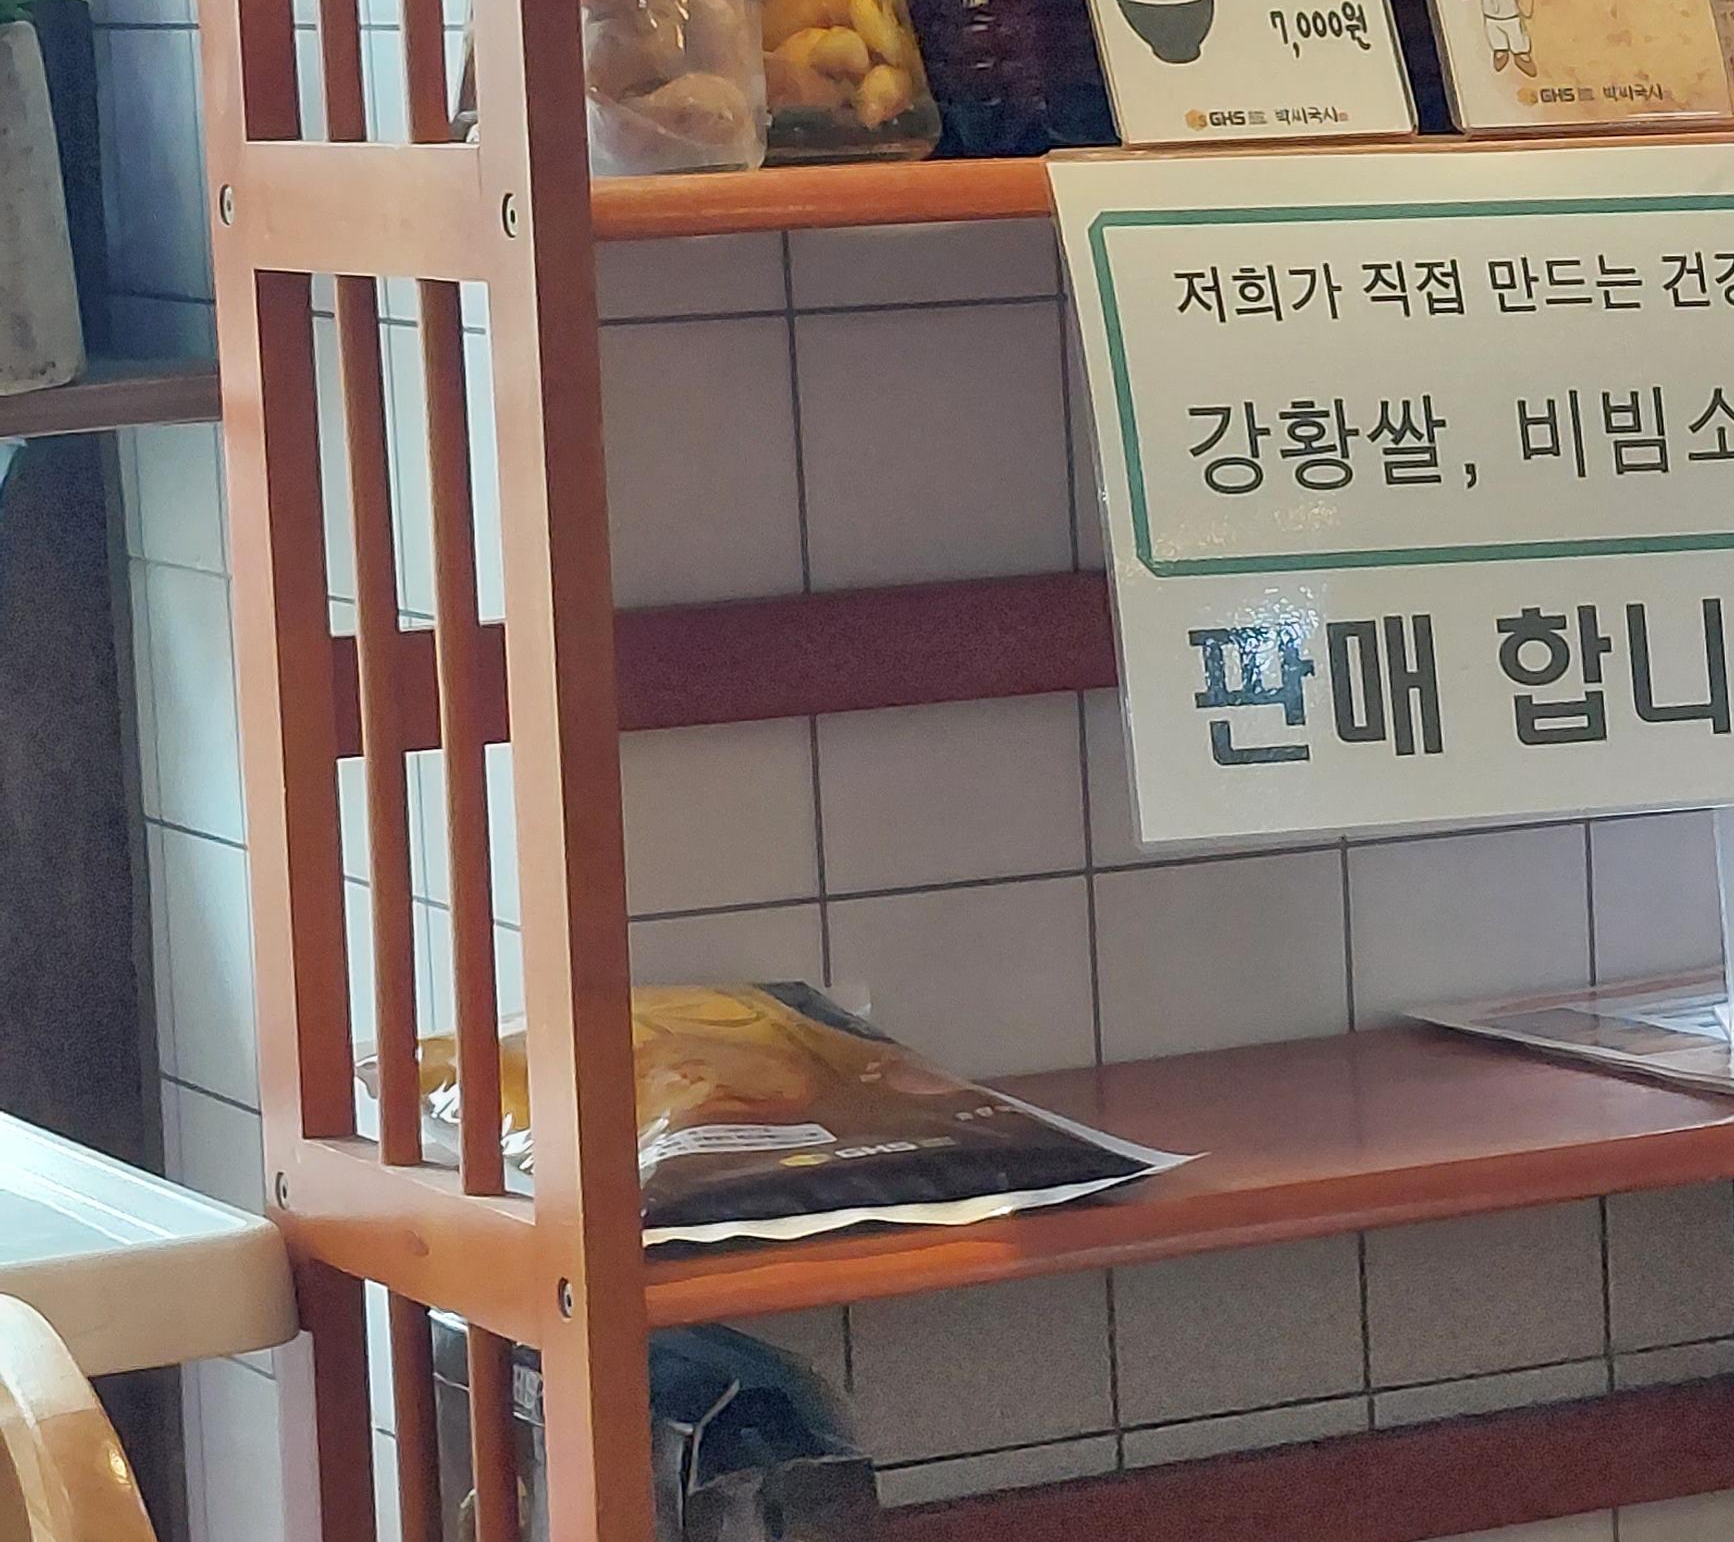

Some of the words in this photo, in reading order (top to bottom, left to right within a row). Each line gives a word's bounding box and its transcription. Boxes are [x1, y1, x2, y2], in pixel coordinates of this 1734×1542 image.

[1269, 1, 1372, 59] 7,000원
[1208, 110, 1246, 127] GHS
[1174, 261, 1343, 325] 저희가
[1361, 258, 1467, 318] 직접
[1488, 251, 1643, 315] 만드는
[1187, 394, 1479, 497] 강황쌀,
[1188, 612, 1446, 767] 판매
